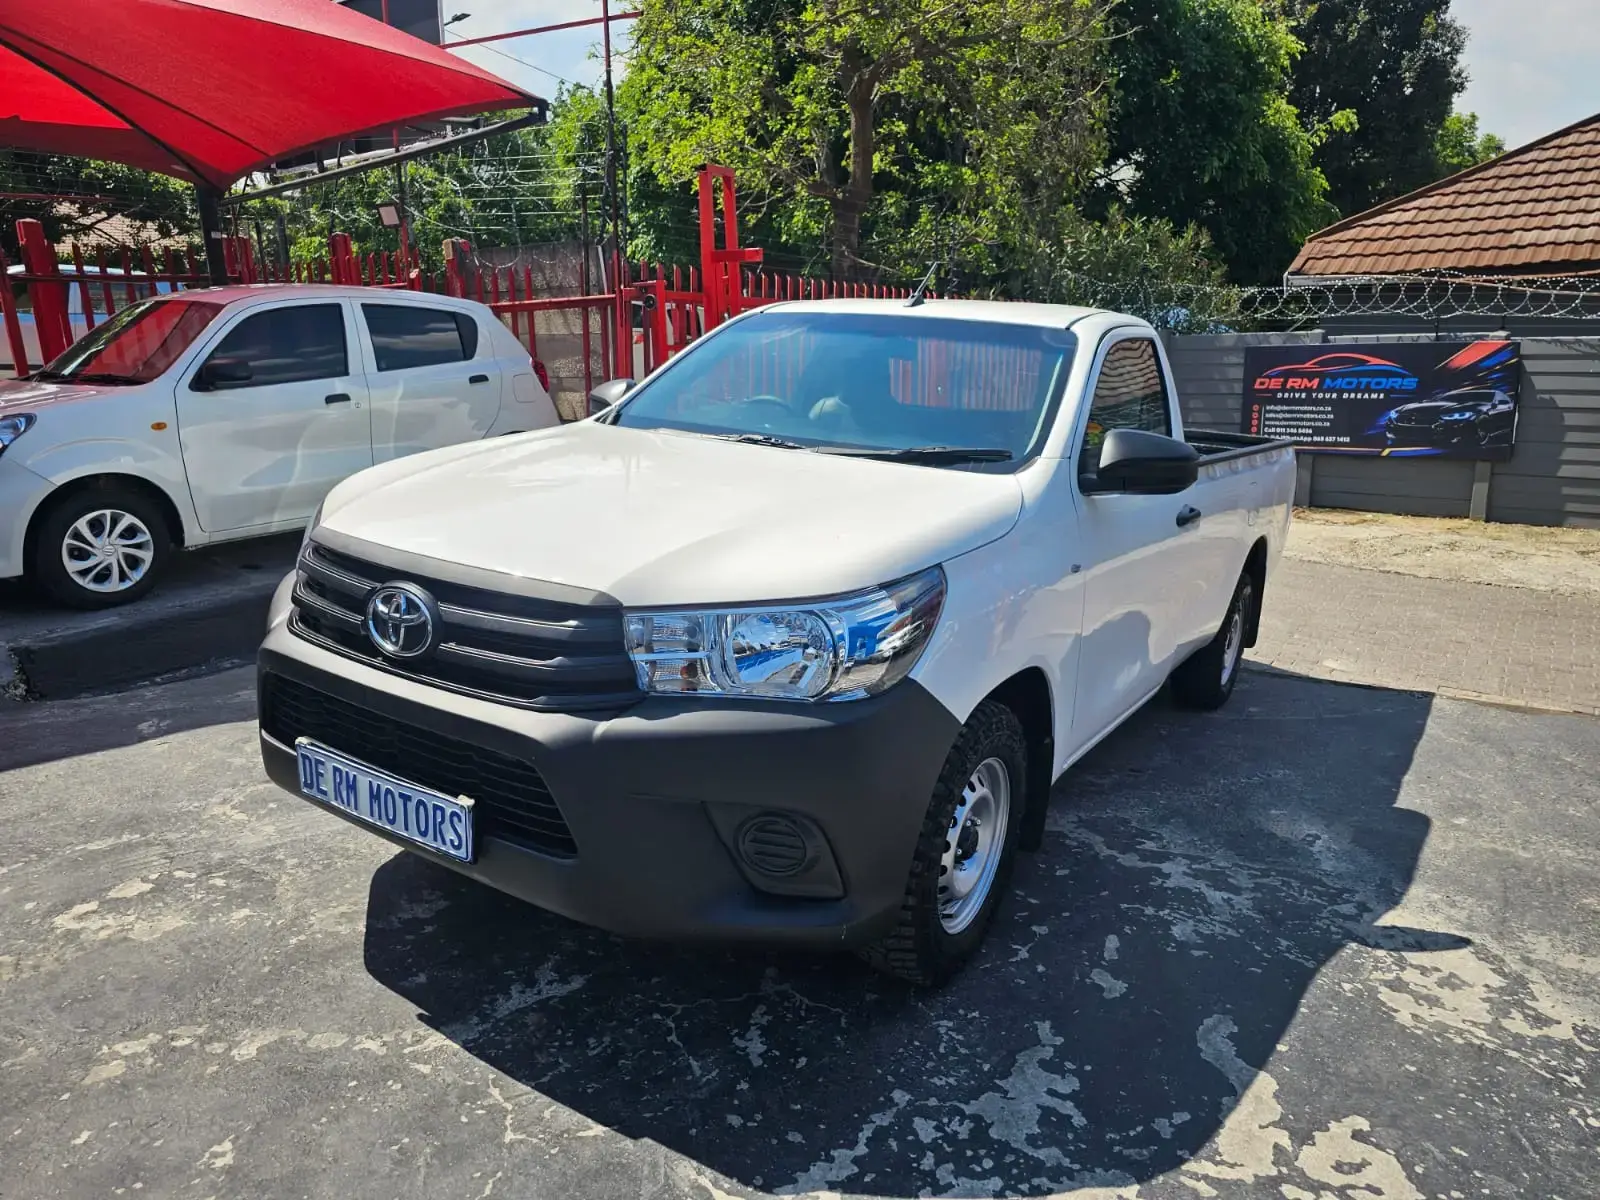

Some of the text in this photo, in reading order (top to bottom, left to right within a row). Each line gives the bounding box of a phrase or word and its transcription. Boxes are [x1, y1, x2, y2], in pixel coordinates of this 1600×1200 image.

[1254, 377, 1419, 390] DE RM MOTORS
[301, 752, 463, 851] DE RM MOTORS
